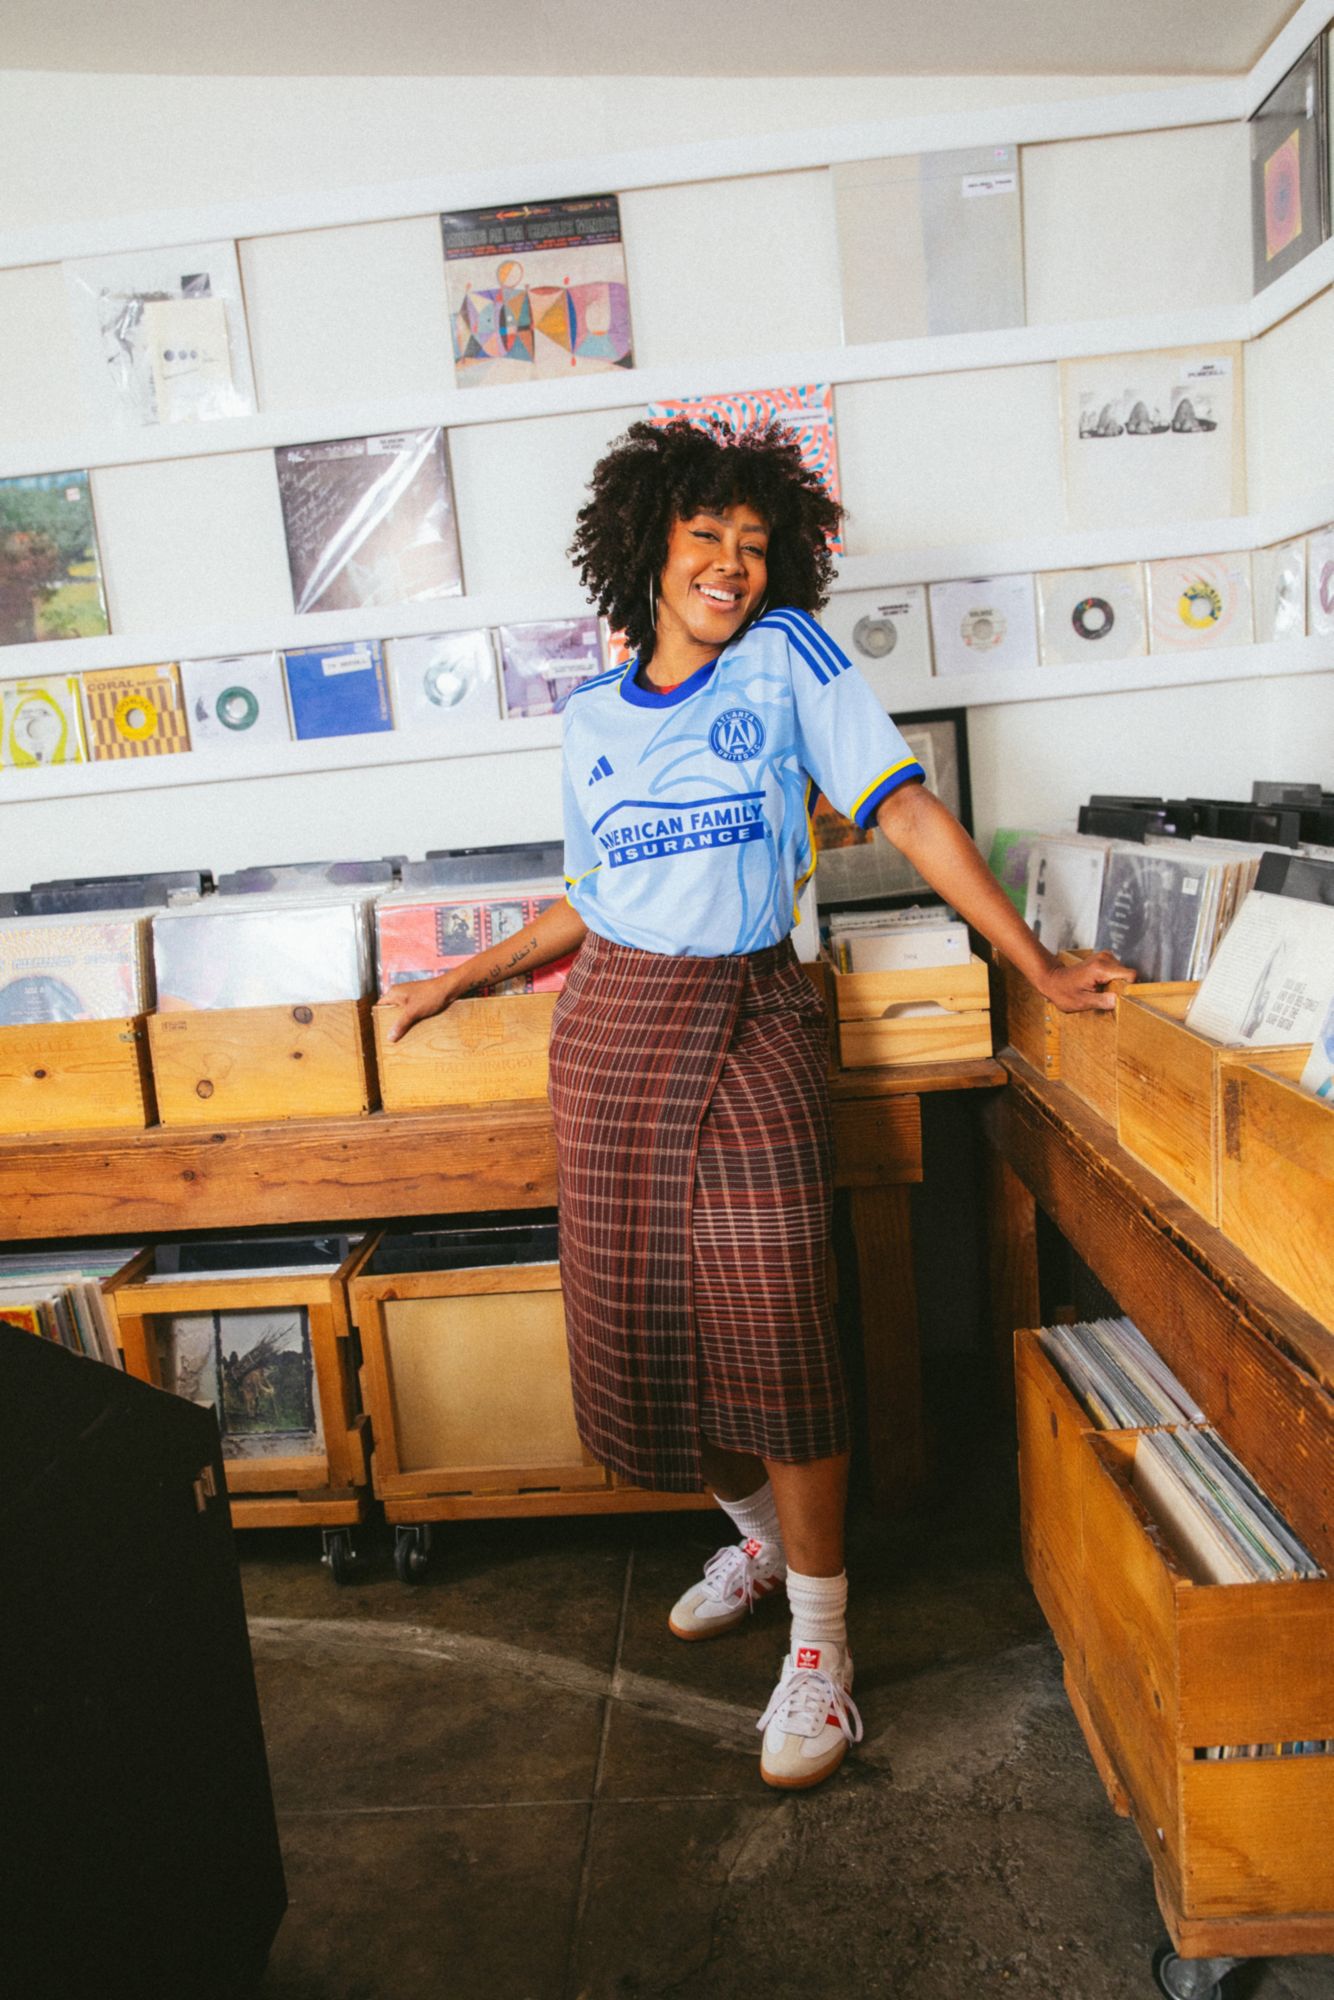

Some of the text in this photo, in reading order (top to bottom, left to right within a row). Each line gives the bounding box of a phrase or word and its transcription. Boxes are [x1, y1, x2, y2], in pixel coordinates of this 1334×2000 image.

[87, 680, 135, 692] CORAL
[716, 711, 755, 727] ATLANTA
[690, 803, 763, 830] FAMILY
[613, 827, 751, 865] NSURANCE
